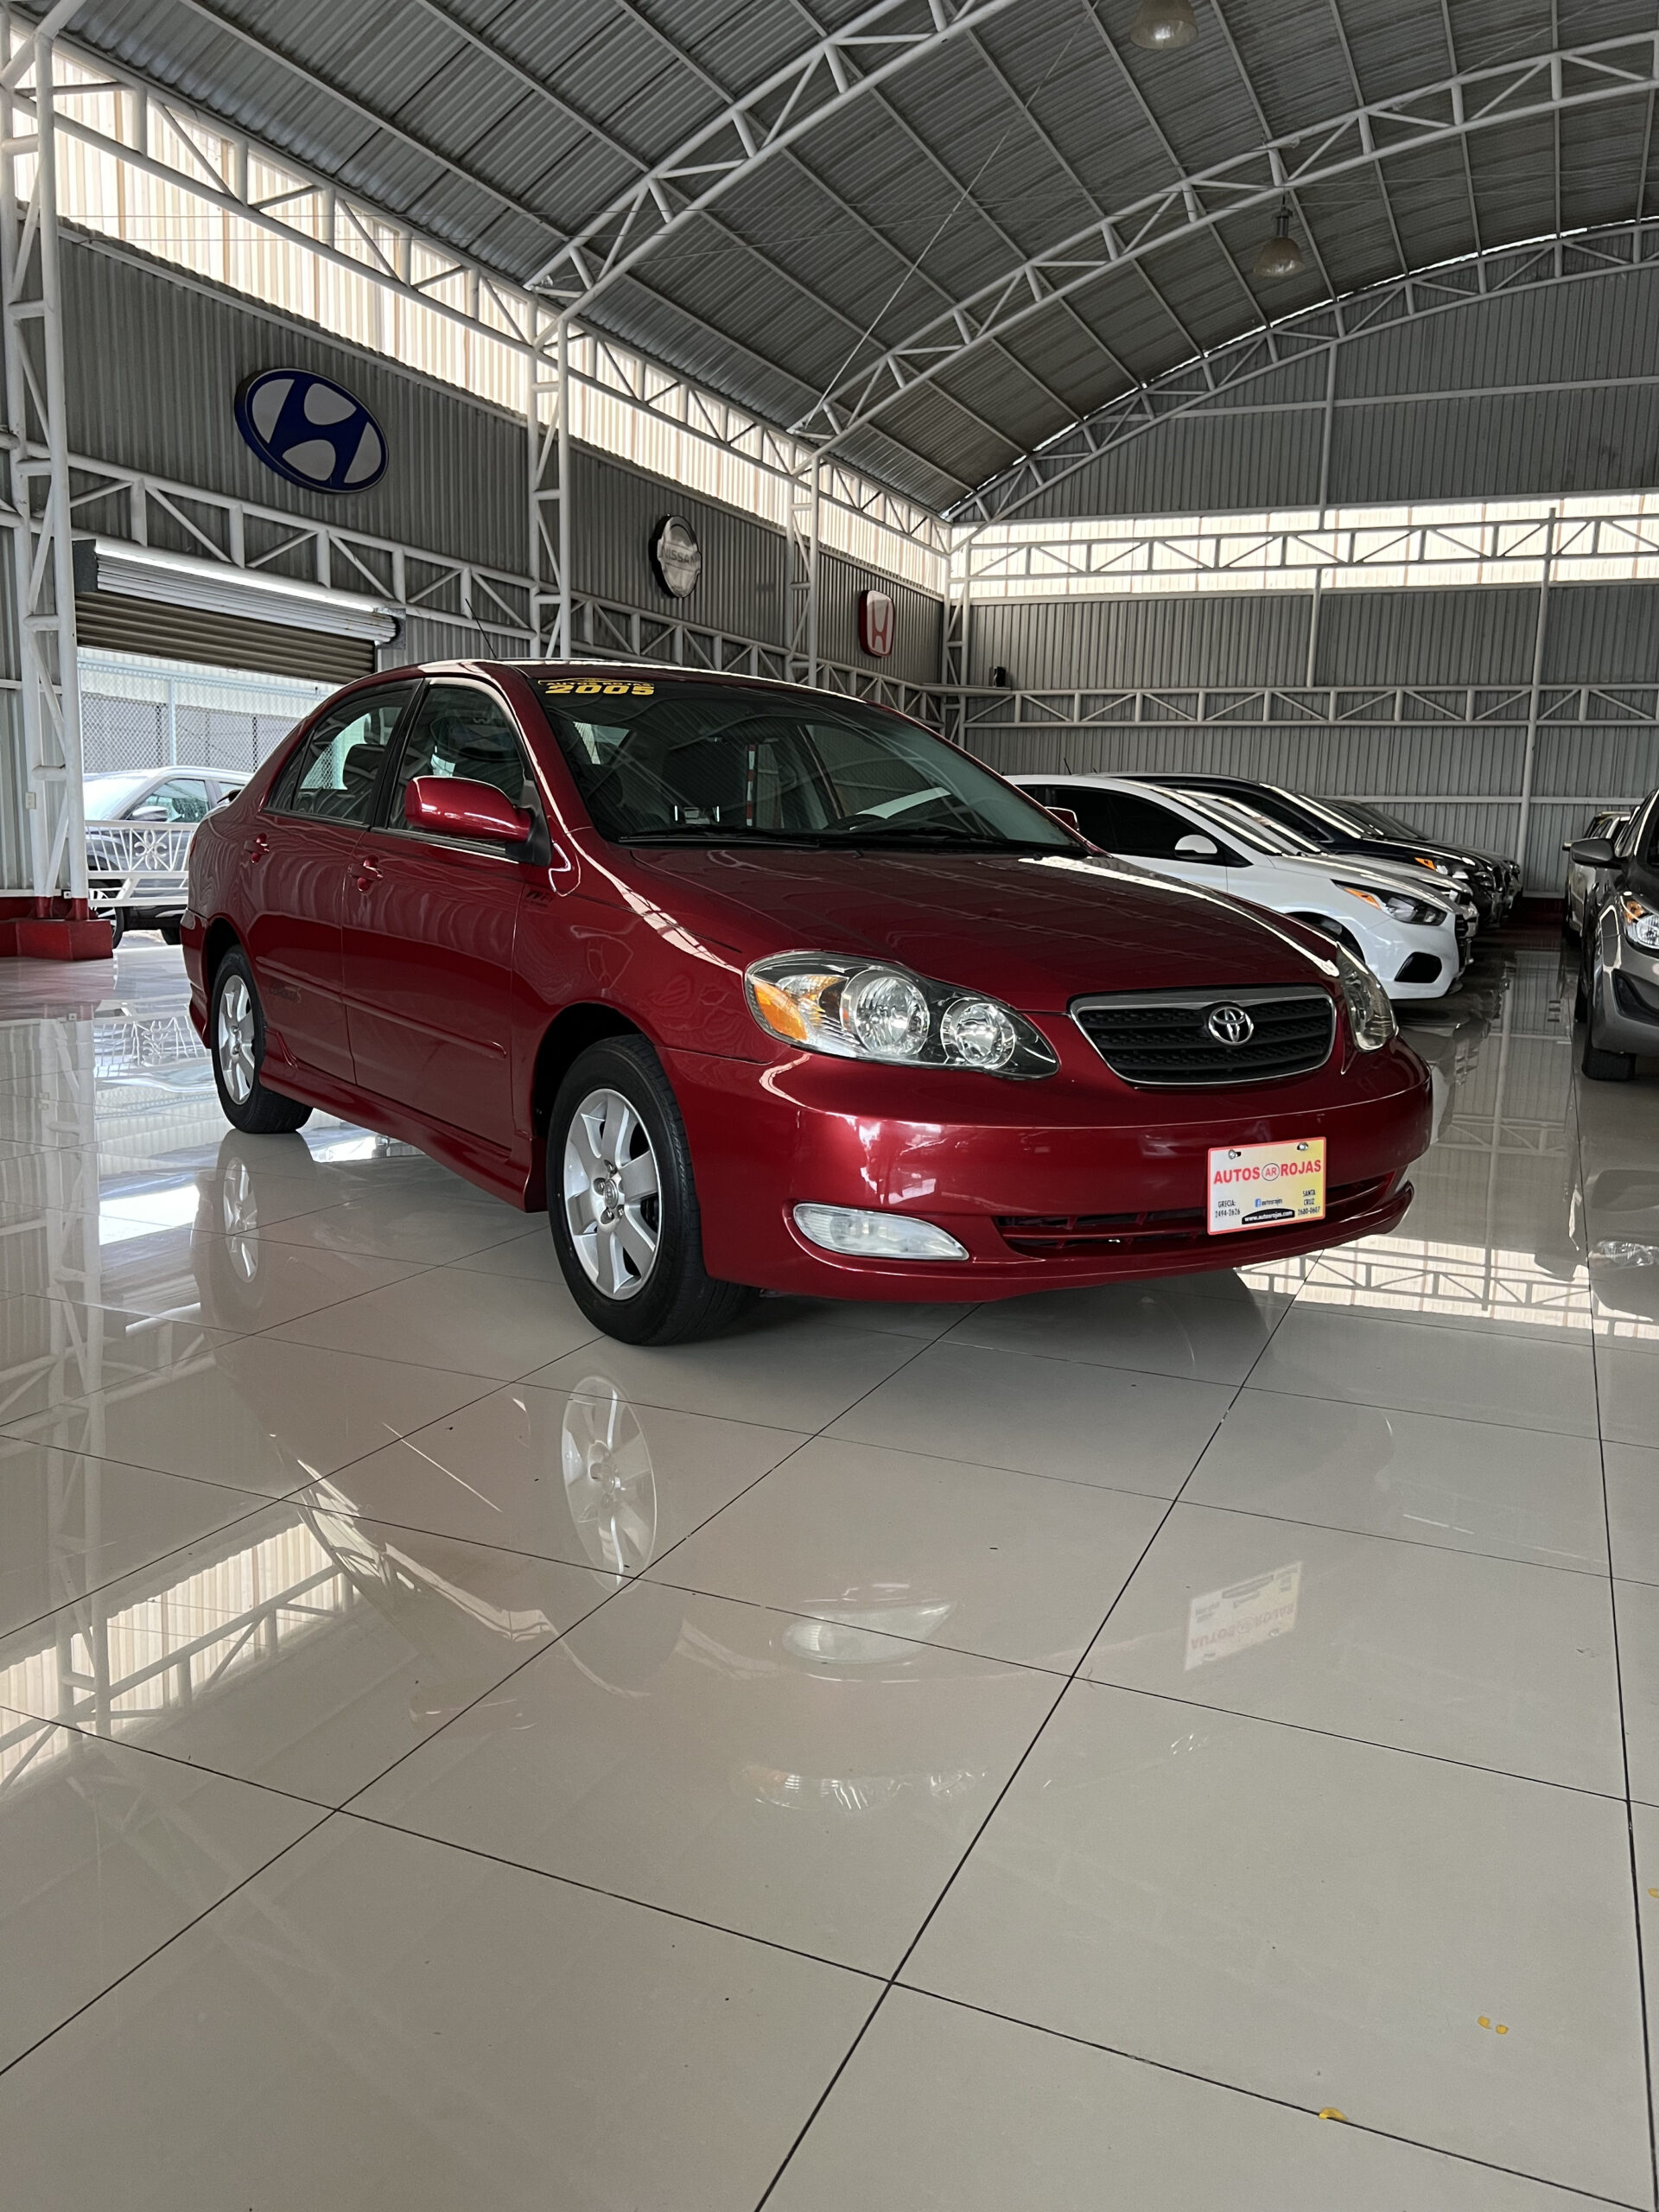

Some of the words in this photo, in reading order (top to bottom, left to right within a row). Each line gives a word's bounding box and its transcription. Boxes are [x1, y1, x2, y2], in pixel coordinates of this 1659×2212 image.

[663, 548, 698, 567] NISSAN
[545, 685, 655, 696] 2005
[1213, 1166, 1261, 1185] AUTOS
[1265, 1166, 1277, 1177] AR
[1281, 1160, 1321, 1177] ROJAS
[1302, 1189, 1316, 1198] SANTA
[1303, 1198, 1315, 1206] CRUZ
